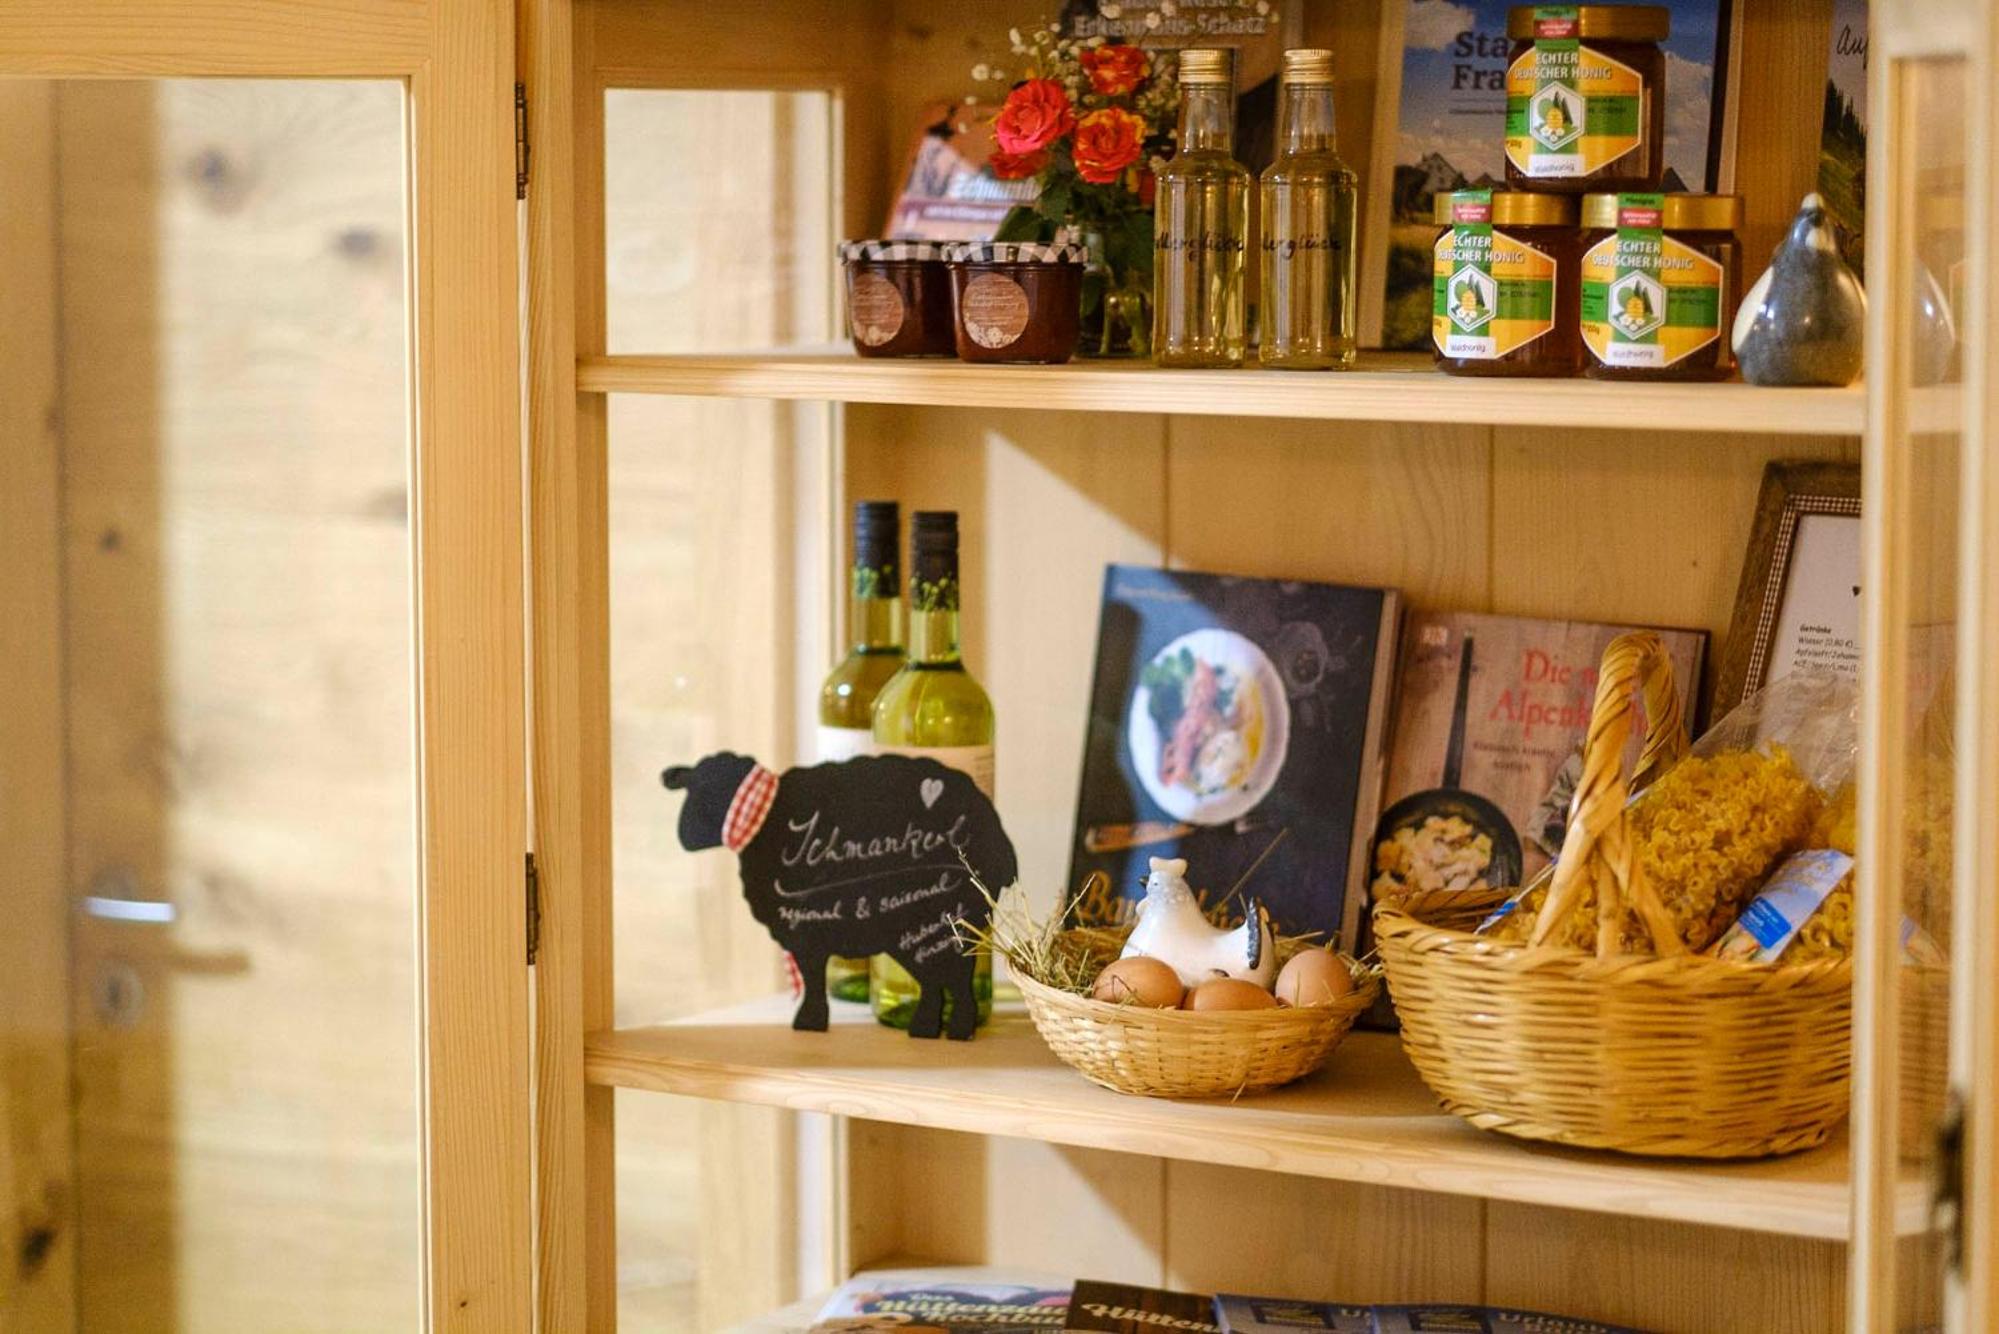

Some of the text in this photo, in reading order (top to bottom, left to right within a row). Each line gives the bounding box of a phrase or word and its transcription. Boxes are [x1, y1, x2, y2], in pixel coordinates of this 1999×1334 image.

[1536, 52, 1579, 65] ECHTER
[1571, 66, 1613, 80] HONIG
[1453, 235, 1493, 248] ECHTER
[1616, 240, 1661, 254] ECHTER
[1485, 250, 1526, 264] HONIG
[1653, 256, 1695, 271] HONIG
[1524, 649, 1571, 684] Die
[856, 896, 871, 920] &
